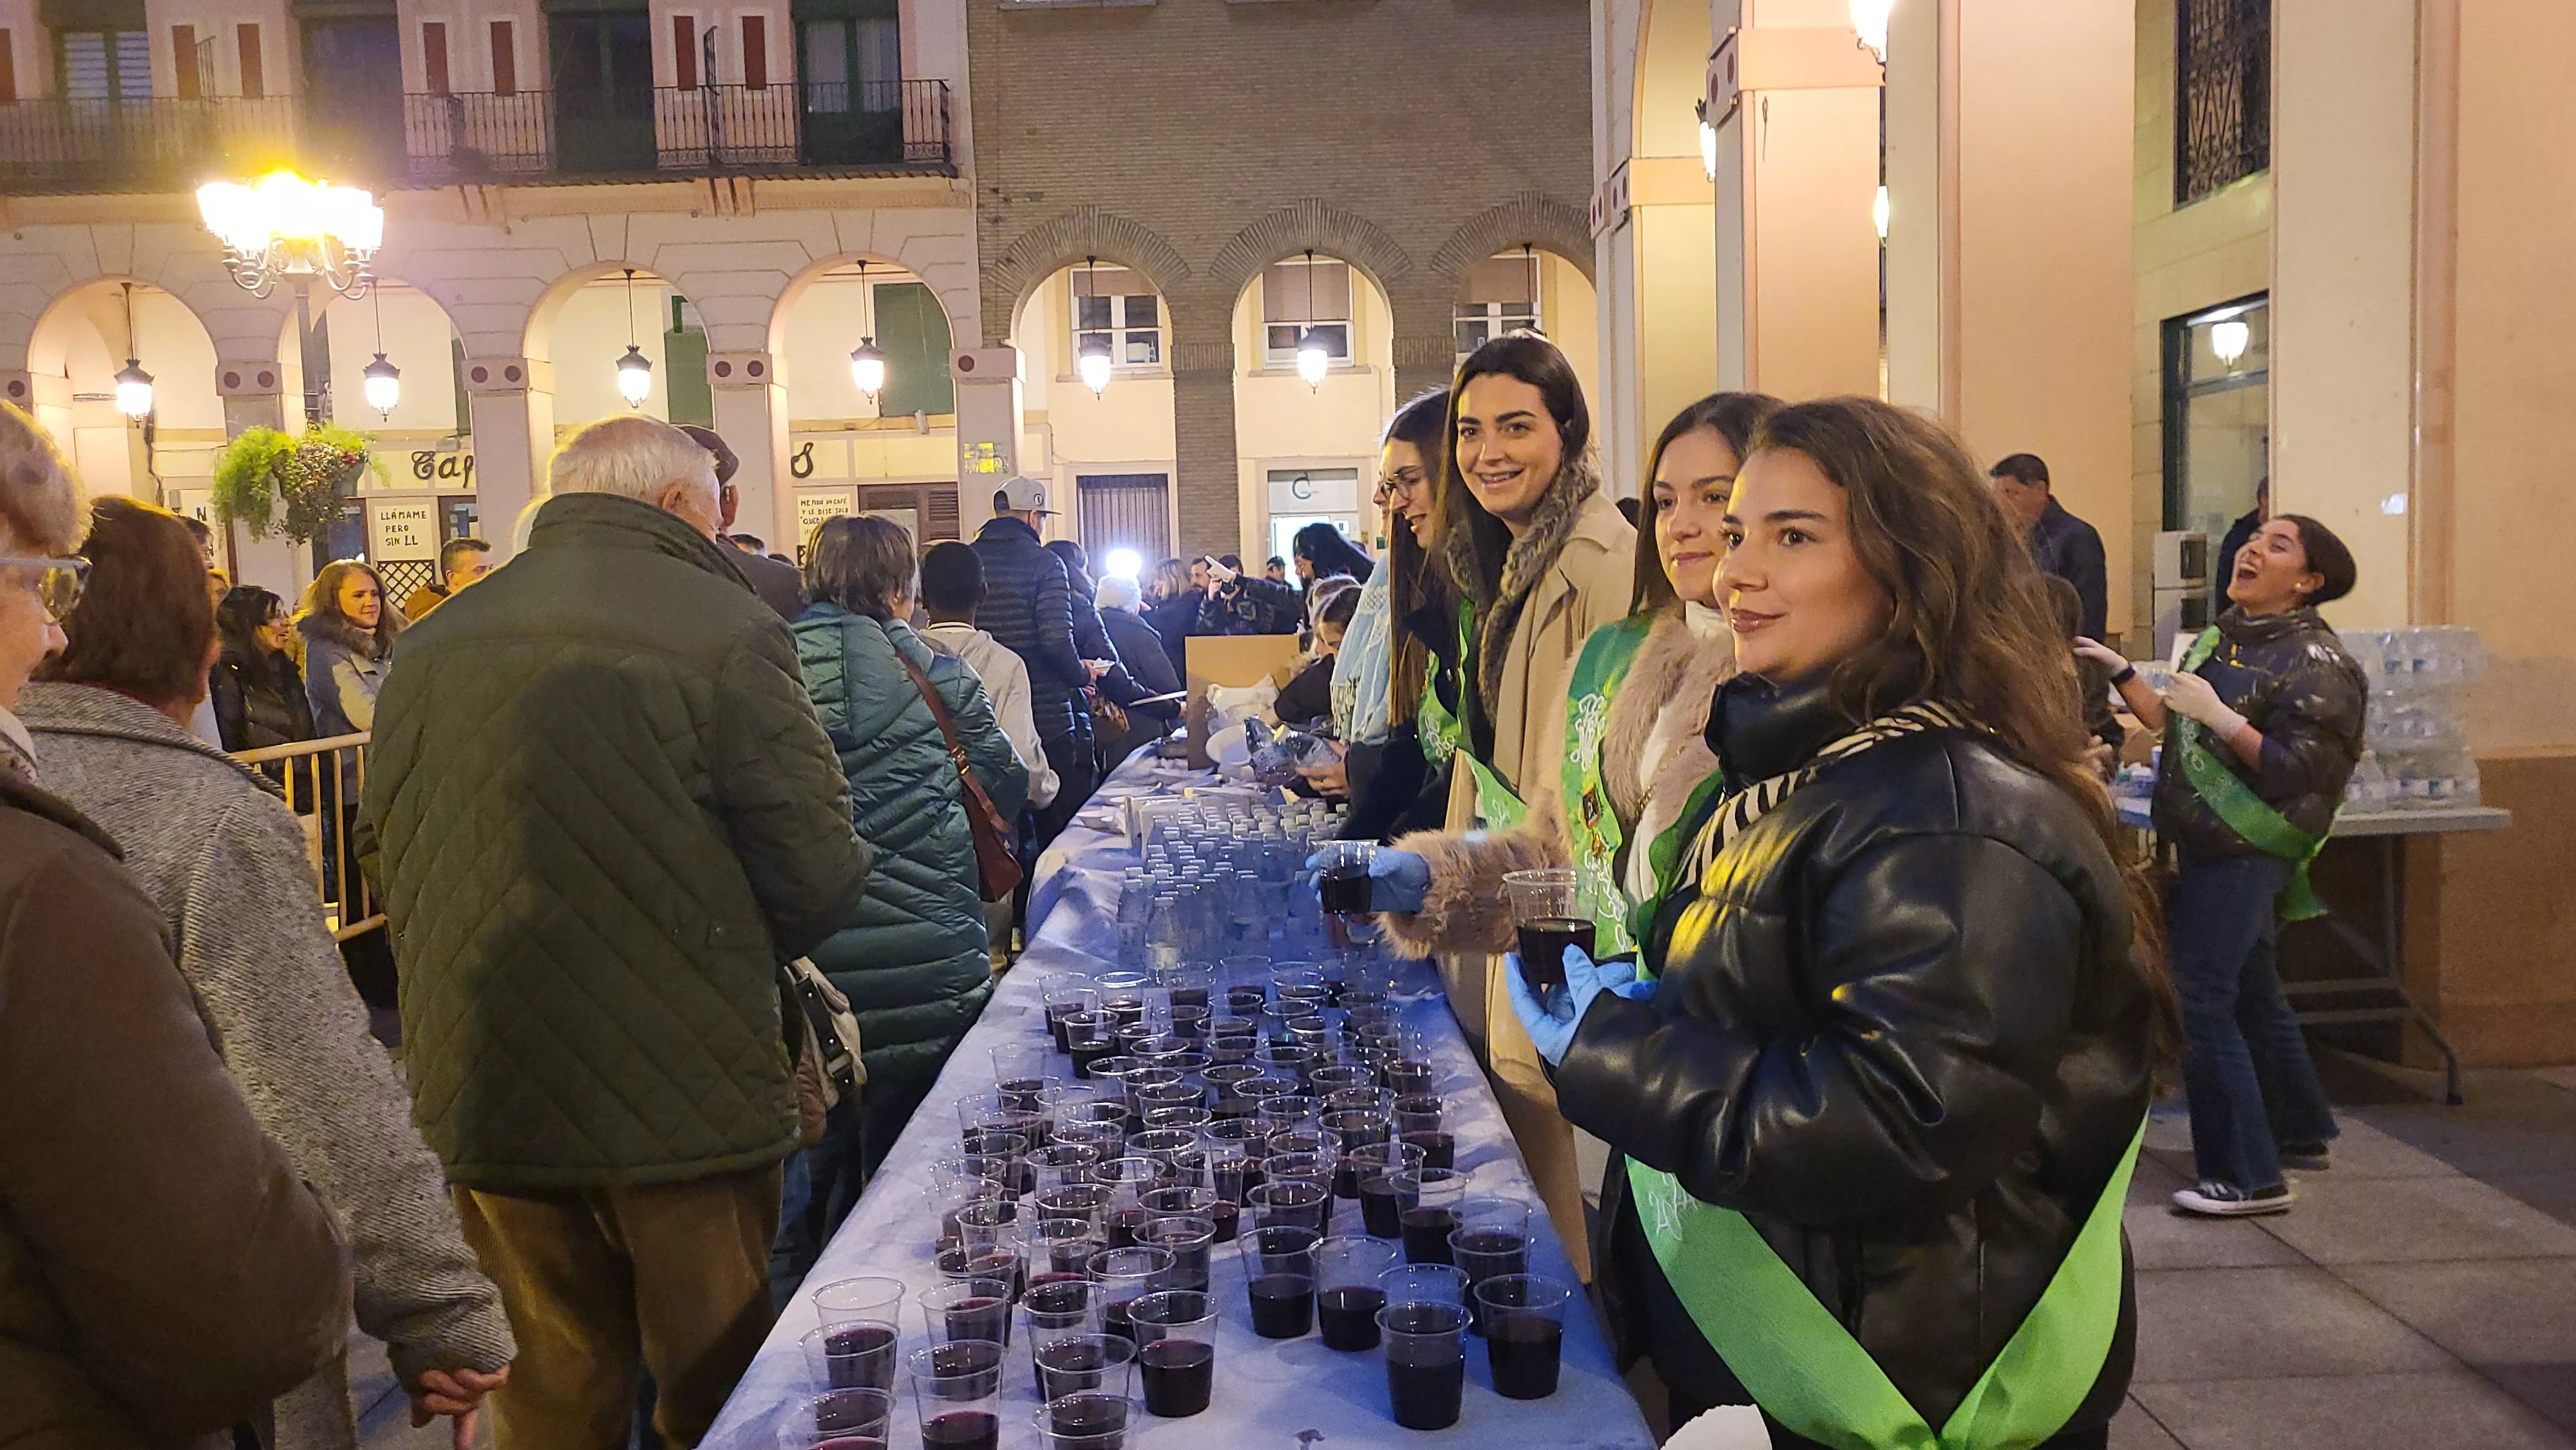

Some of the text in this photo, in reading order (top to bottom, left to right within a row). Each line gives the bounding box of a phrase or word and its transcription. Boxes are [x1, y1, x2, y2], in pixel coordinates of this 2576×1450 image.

[833, 496, 848, 505] CAFÉ
[381, 508, 426, 520] LLÁMAME
[385, 525, 409, 533] PERO
[385, 535, 419, 546] SIN LL
